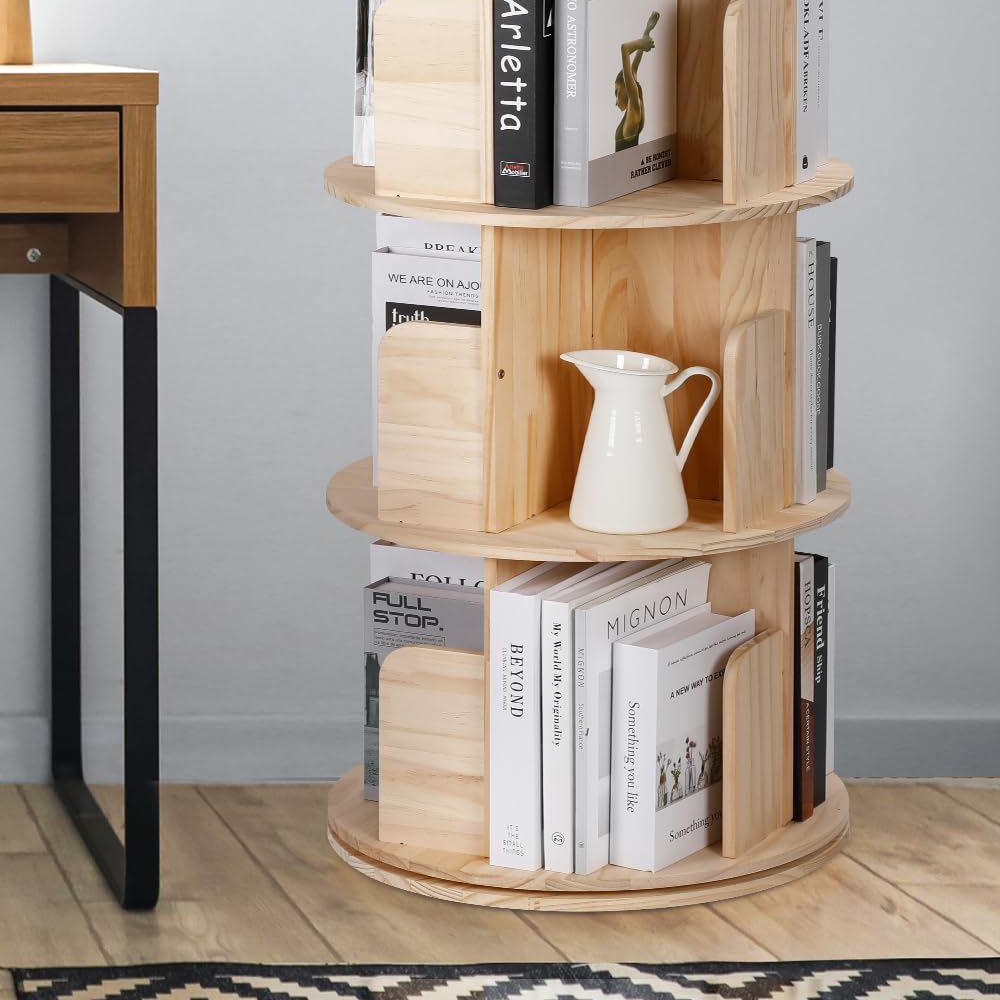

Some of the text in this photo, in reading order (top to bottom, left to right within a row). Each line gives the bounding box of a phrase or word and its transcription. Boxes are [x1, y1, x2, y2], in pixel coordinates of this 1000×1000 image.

[566, 15, 577, 99] ASTRONOMER
[631, 165, 652, 179] RATHER
[388, 273, 481, 291] WE ARE ON AJO
[373, 592, 431, 612] FULL
[373, 610, 444, 631] STOP.
[607, 588, 688, 640] MIGNON
[815, 584, 826, 684] Friend Ship
[510, 643, 523, 718] BEYOND
[551, 622, 562, 746] My World My Originality
[669, 691, 675, 699] A
[675, 685, 690, 697] NEW
[691, 677, 704, 690] WAY
[704, 674, 713, 684] TO
[624, 701, 640, 813] Something you like
[669, 815, 711, 842] Something
